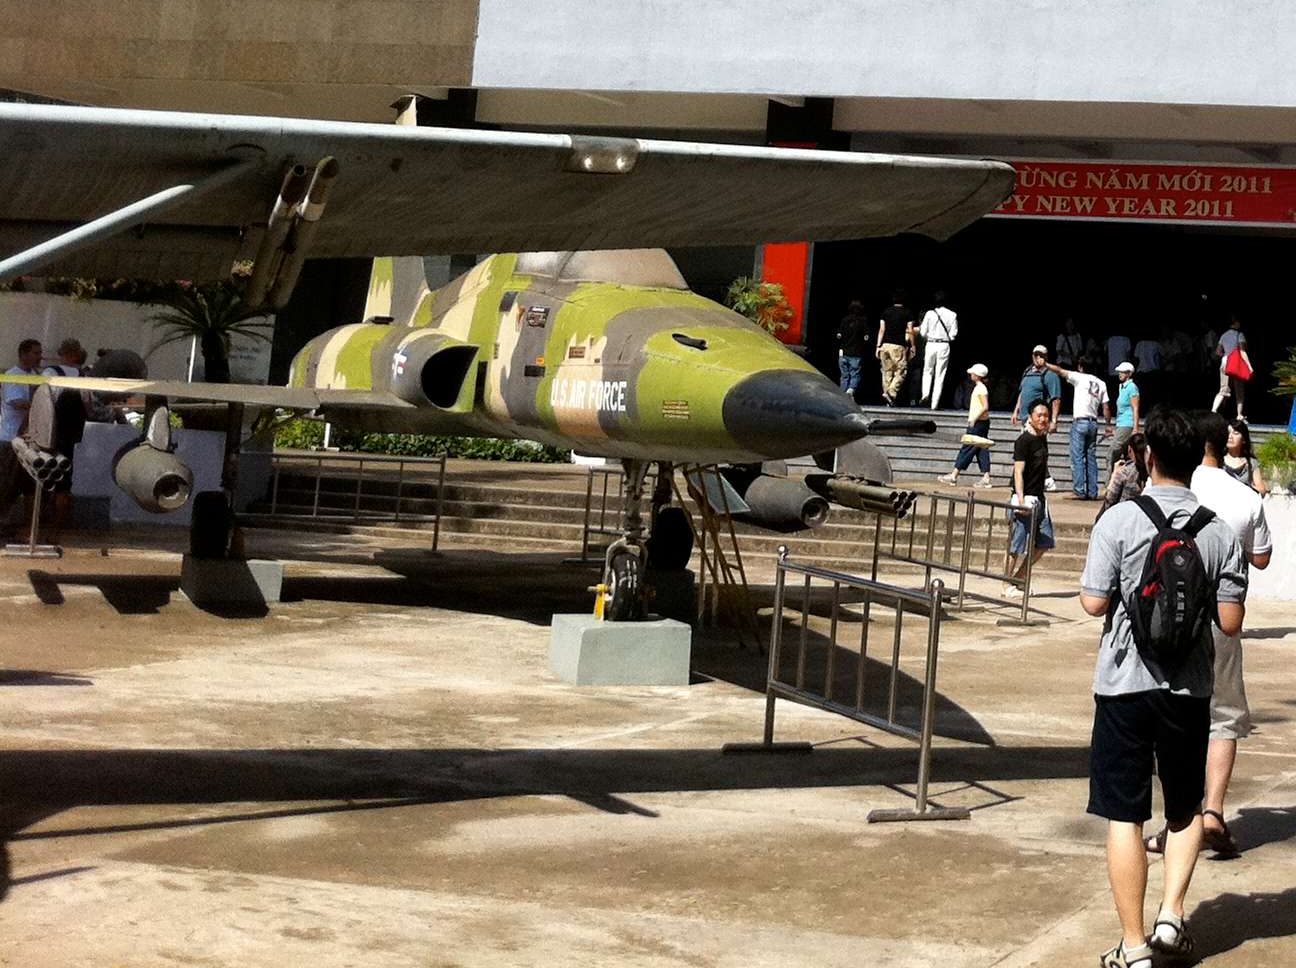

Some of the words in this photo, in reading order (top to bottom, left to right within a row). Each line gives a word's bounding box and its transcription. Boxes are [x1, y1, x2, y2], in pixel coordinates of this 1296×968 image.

[1014, 165, 1078, 188] ỪNG
[1085, 168, 1151, 190] NĂM
[1156, 169, 1214, 191] MỚI
[1218, 175, 1272, 194] 2011
[1036, 195, 1098, 213] NEW
[1104, 196, 1177, 215] YEAR
[1183, 199, 1234, 217] 2011
[569, 379, 587, 409] AIR
[588, 380, 628, 412] FORCE
